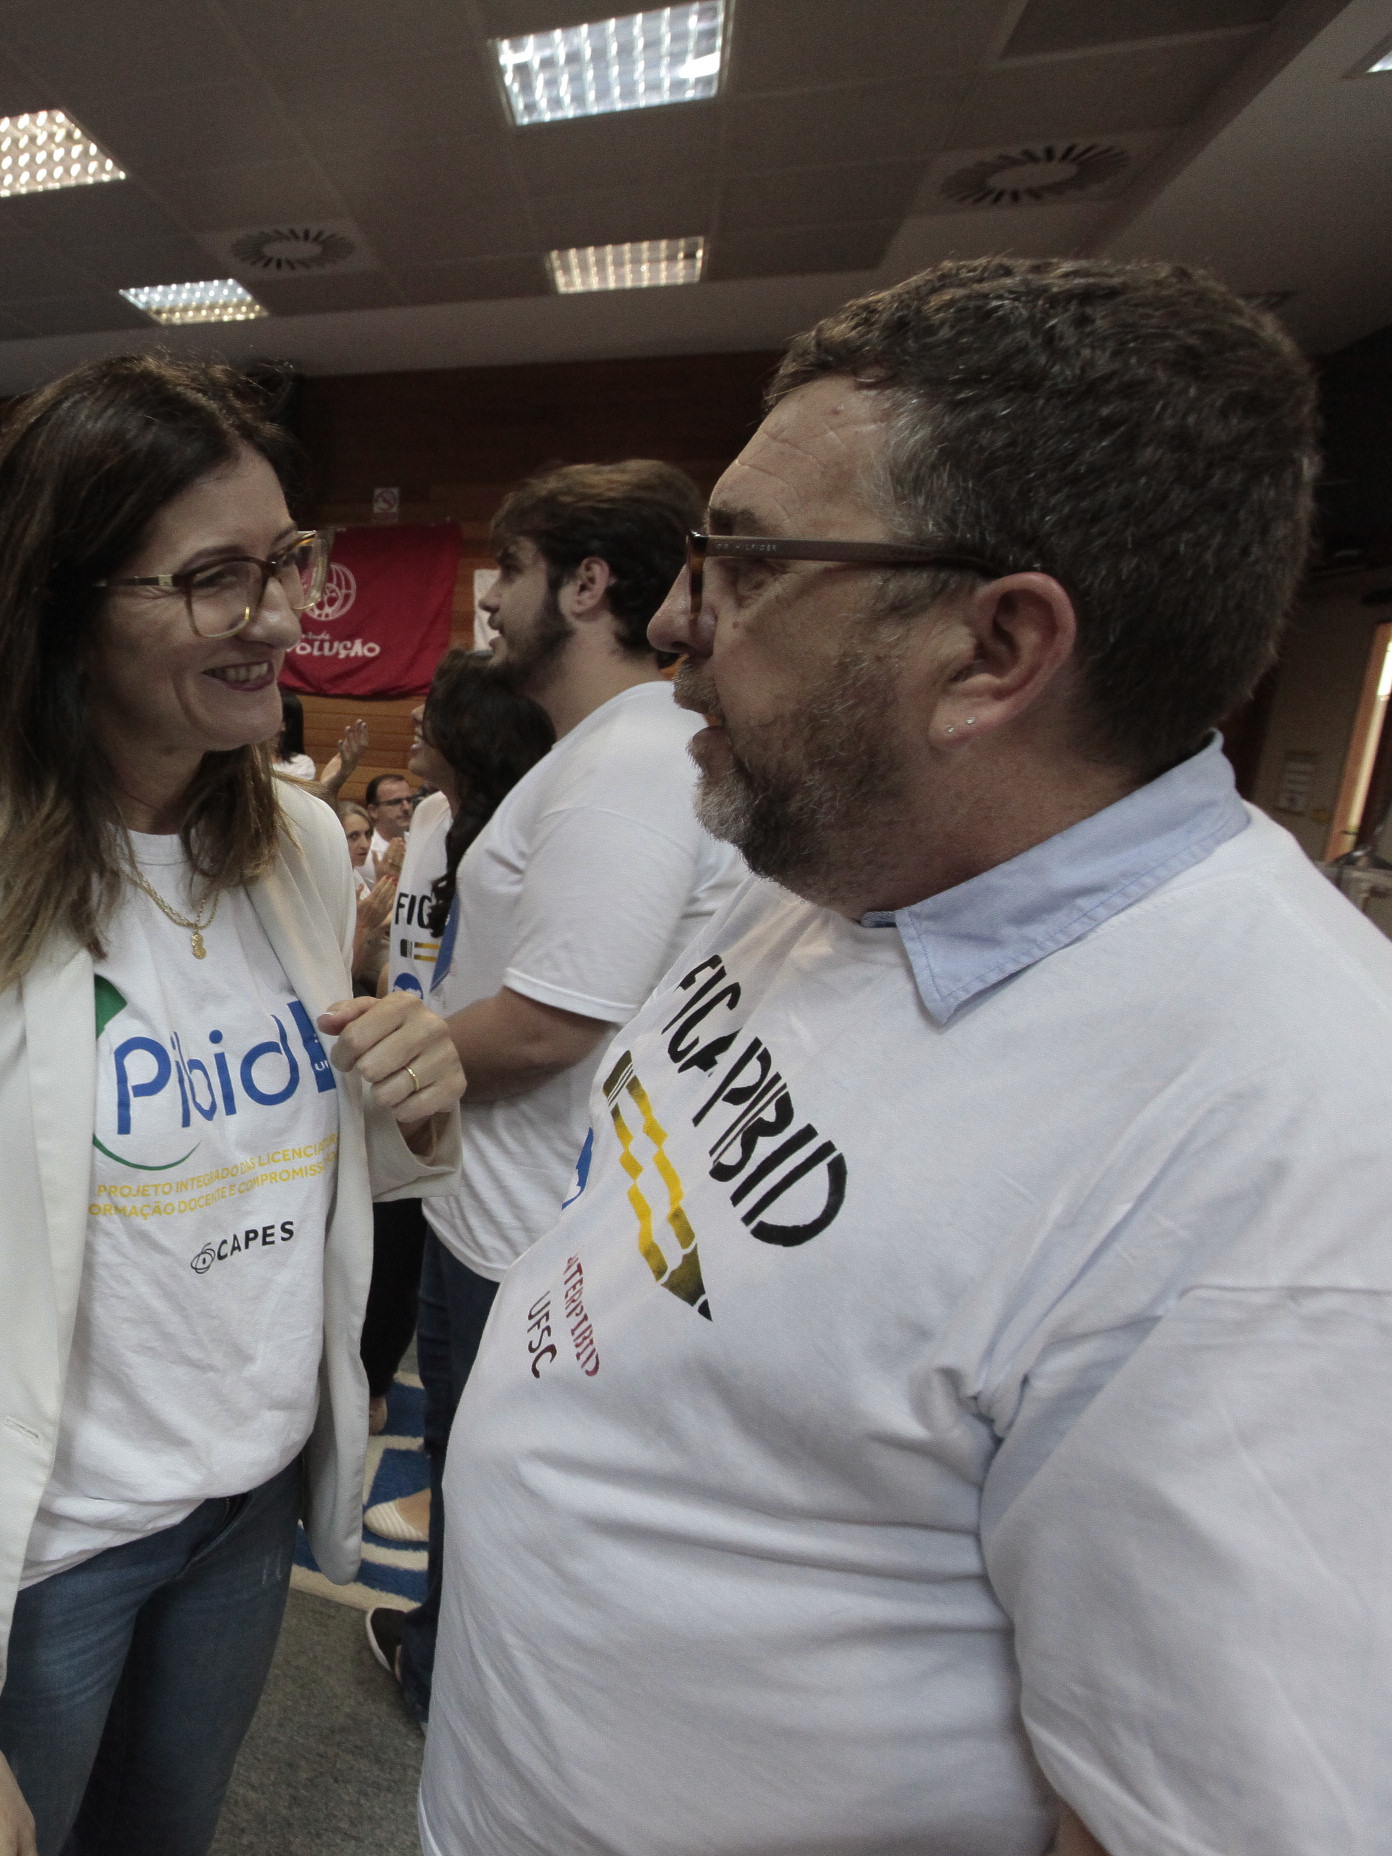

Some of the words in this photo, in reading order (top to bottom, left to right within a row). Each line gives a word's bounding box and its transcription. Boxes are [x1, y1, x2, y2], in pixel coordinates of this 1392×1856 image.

[96, 1180, 173, 1198] PROJETO
[229, 1184, 236, 1197] E
[216, 1220, 295, 1261] CAPES
[526, 1290, 557, 1379] UFSC
